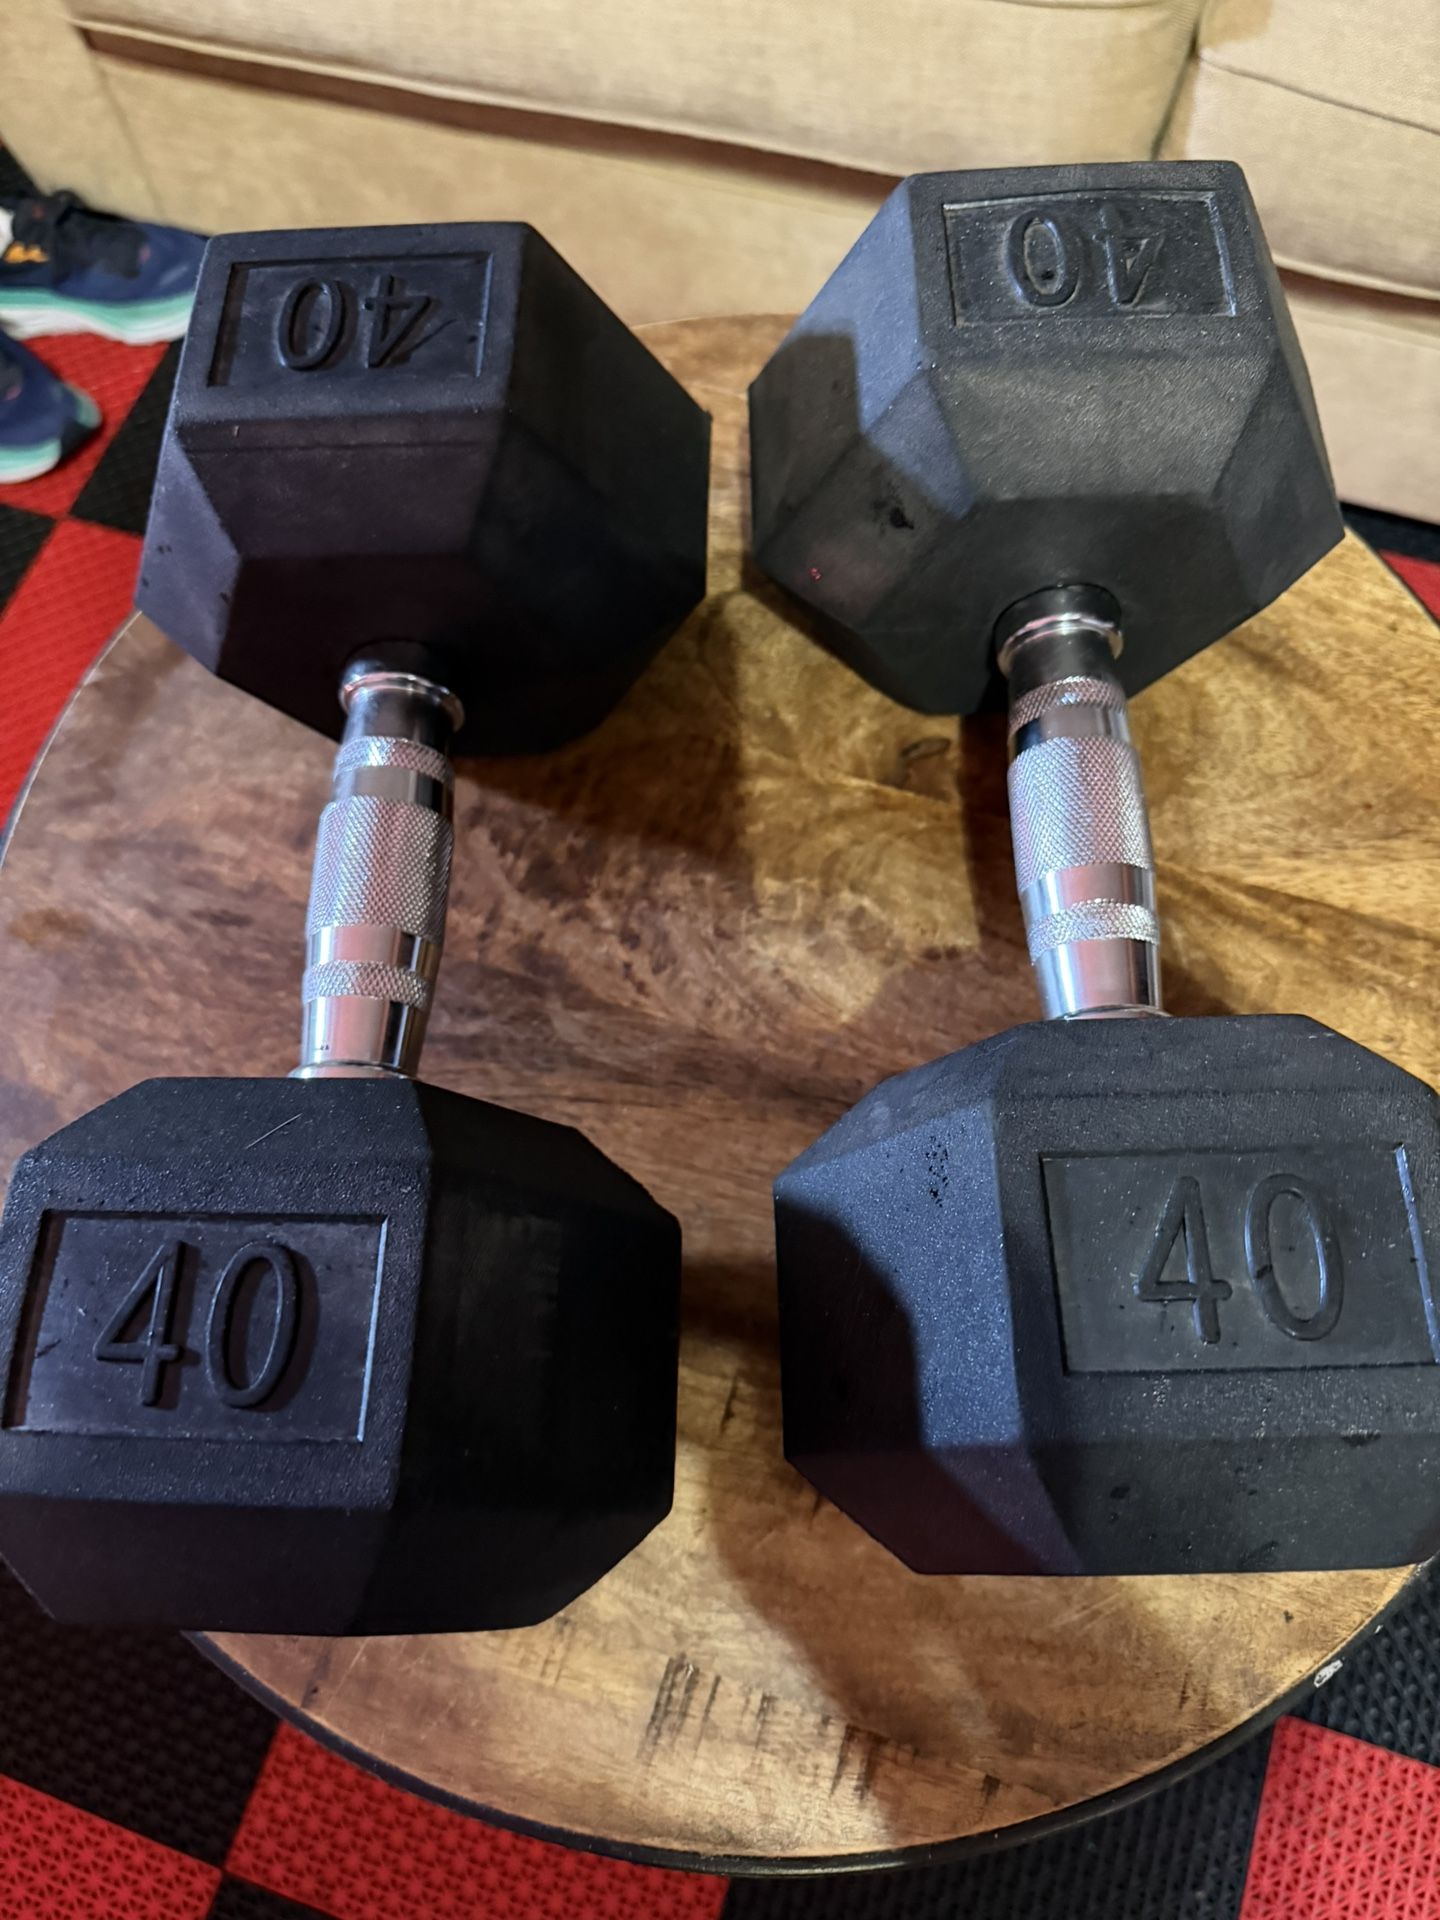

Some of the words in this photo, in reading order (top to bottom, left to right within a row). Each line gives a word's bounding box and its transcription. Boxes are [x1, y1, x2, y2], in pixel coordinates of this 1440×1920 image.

[277, 275, 430, 371] 40
[1003, 204, 1164, 308] 40
[93, 1240, 302, 1410] 40
[1134, 1173, 1344, 1344] 40
